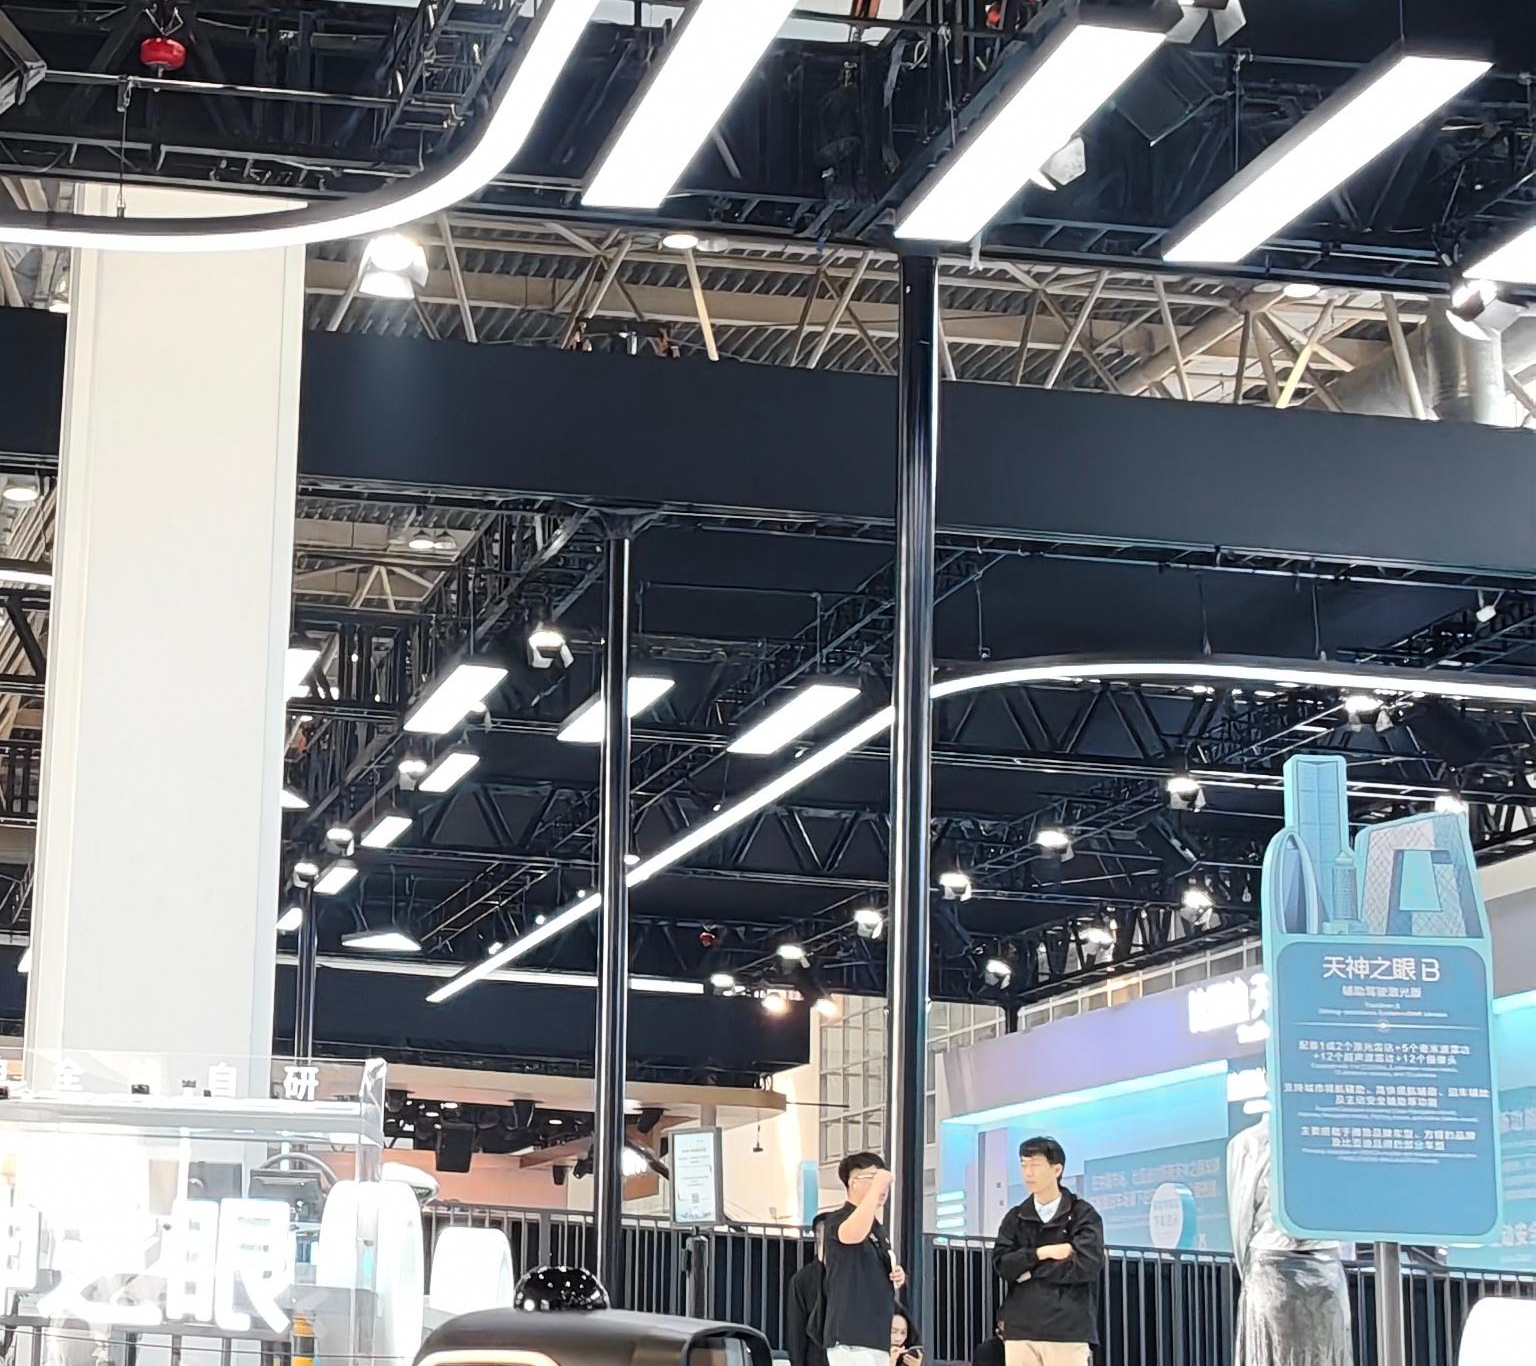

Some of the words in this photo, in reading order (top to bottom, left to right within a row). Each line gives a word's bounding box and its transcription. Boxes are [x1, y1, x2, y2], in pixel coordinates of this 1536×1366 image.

[1322, 955, 1417, 981] 天神之眼
[1421, 958, 1441, 982] B
